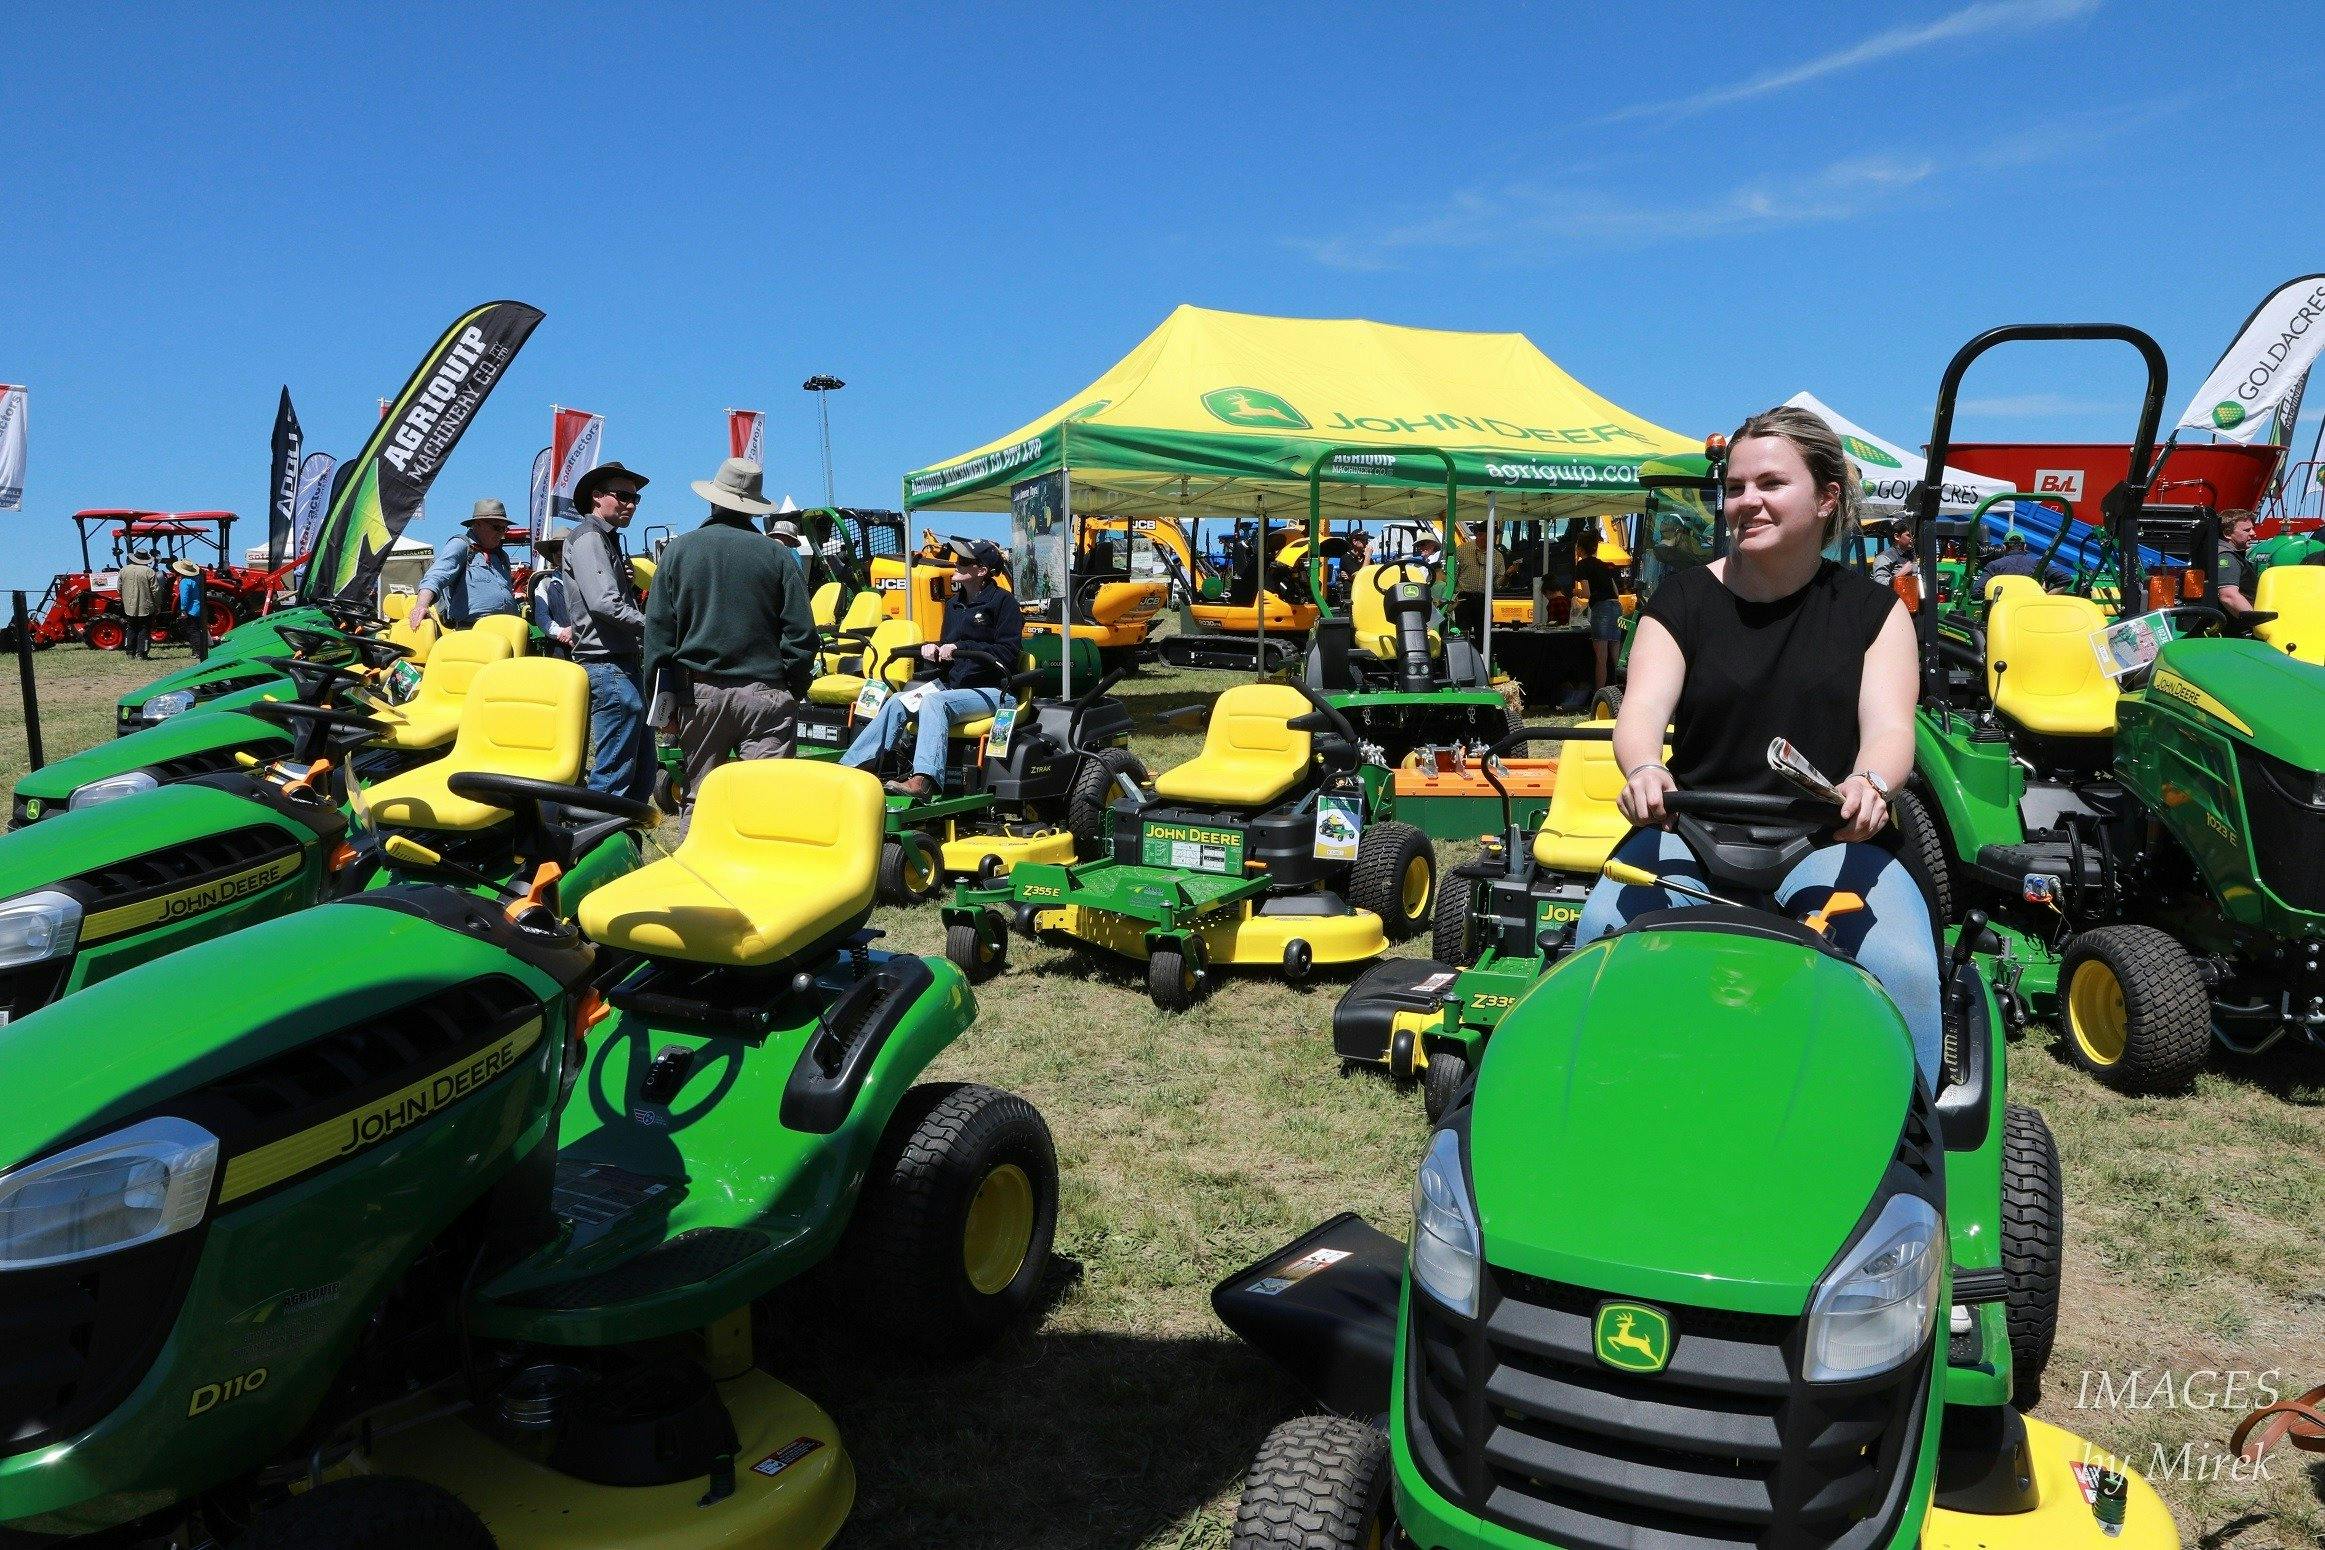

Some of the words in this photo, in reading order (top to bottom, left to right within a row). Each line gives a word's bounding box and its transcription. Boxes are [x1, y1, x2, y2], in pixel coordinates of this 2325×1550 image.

[384, 325, 487, 472] AGRIQUIP
[407, 382, 481, 483] MACHINERY
[1327, 411, 1483, 433] JOHN
[1480, 416, 1661, 447] DEERE
[1877, 479, 1979, 505] GOLCRES
[876, 578, 907, 590] JCB
[2155, 676, 2177, 698] JOHN
[2176, 683, 2201, 705] DEERE
[1145, 824, 1186, 841] JOHN
[1189, 828, 1241, 847] DEERE
[158, 889, 217, 921] JOHN
[219, 865, 281, 900] DEERE
[1540, 904, 1583, 922] JOH
[341, 1090, 427, 1152] JOHN
[432, 1040, 515, 1108] DEERE
[187, 1367, 268, 1418] D110
